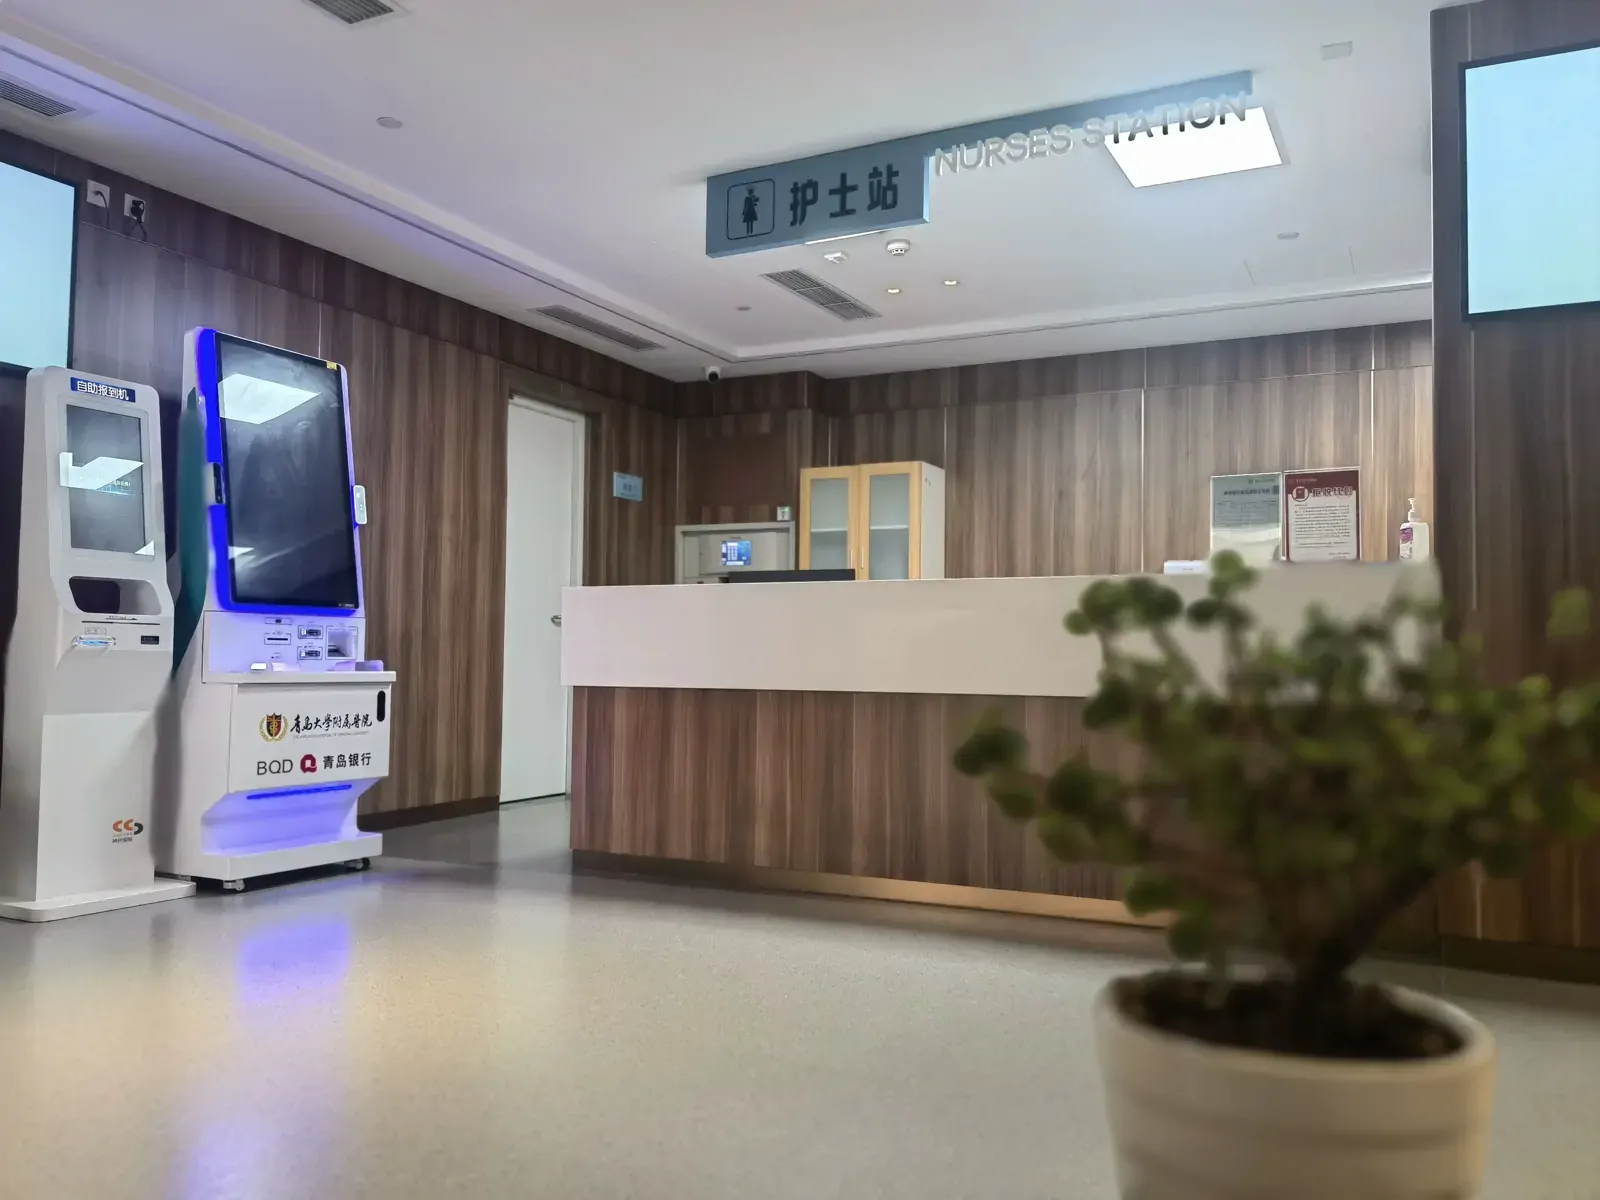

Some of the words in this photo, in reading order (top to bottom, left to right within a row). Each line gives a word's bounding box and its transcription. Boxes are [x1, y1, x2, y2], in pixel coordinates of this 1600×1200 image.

[934, 123, 1074, 176] NURSES
[1082, 90, 1248, 147] STATION
[788, 163, 900, 227] 护士站
[77, 380, 129, 401] 自助报到机
[256, 759, 293, 776] BQD
[323, 752, 372, 770] 青岛银行
